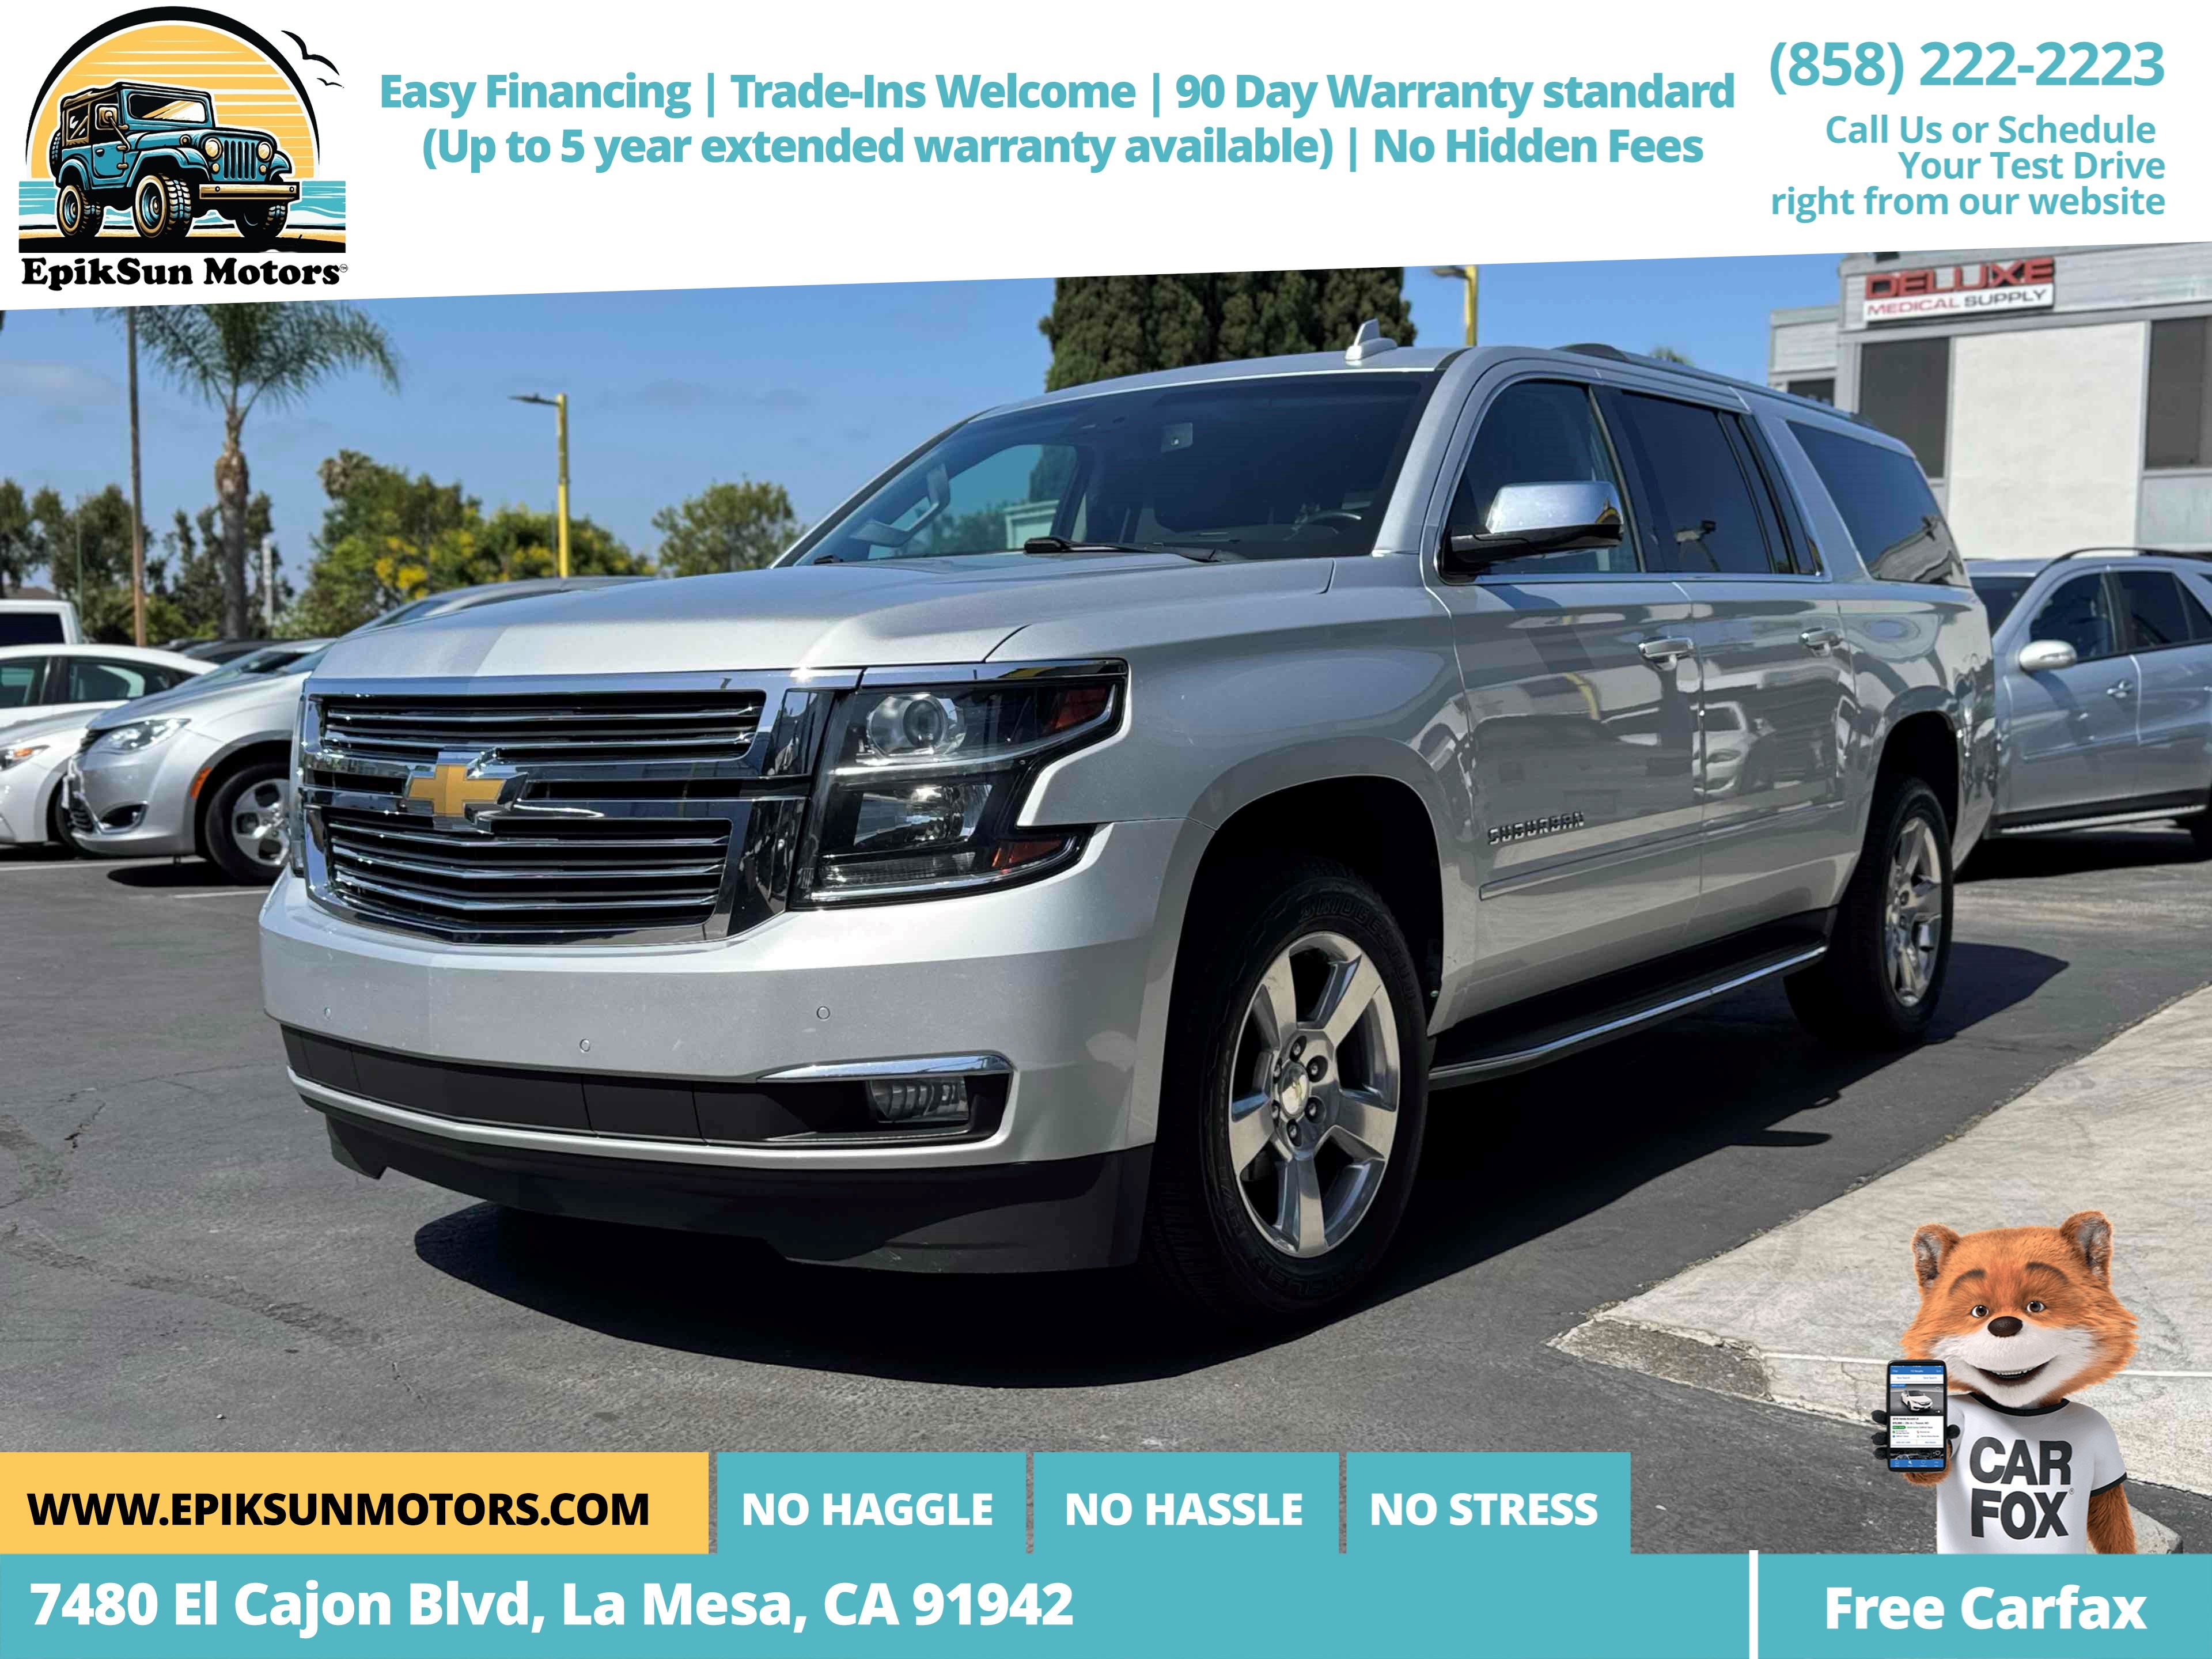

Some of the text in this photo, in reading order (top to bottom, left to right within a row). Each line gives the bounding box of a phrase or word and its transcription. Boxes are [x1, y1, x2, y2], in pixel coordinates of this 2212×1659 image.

[1865, 257, 2055, 300] DELUXE
[1867, 289, 2047, 316] MEDICAL SUPPLY
[1488, 810, 1584, 845] SUBURBAN
